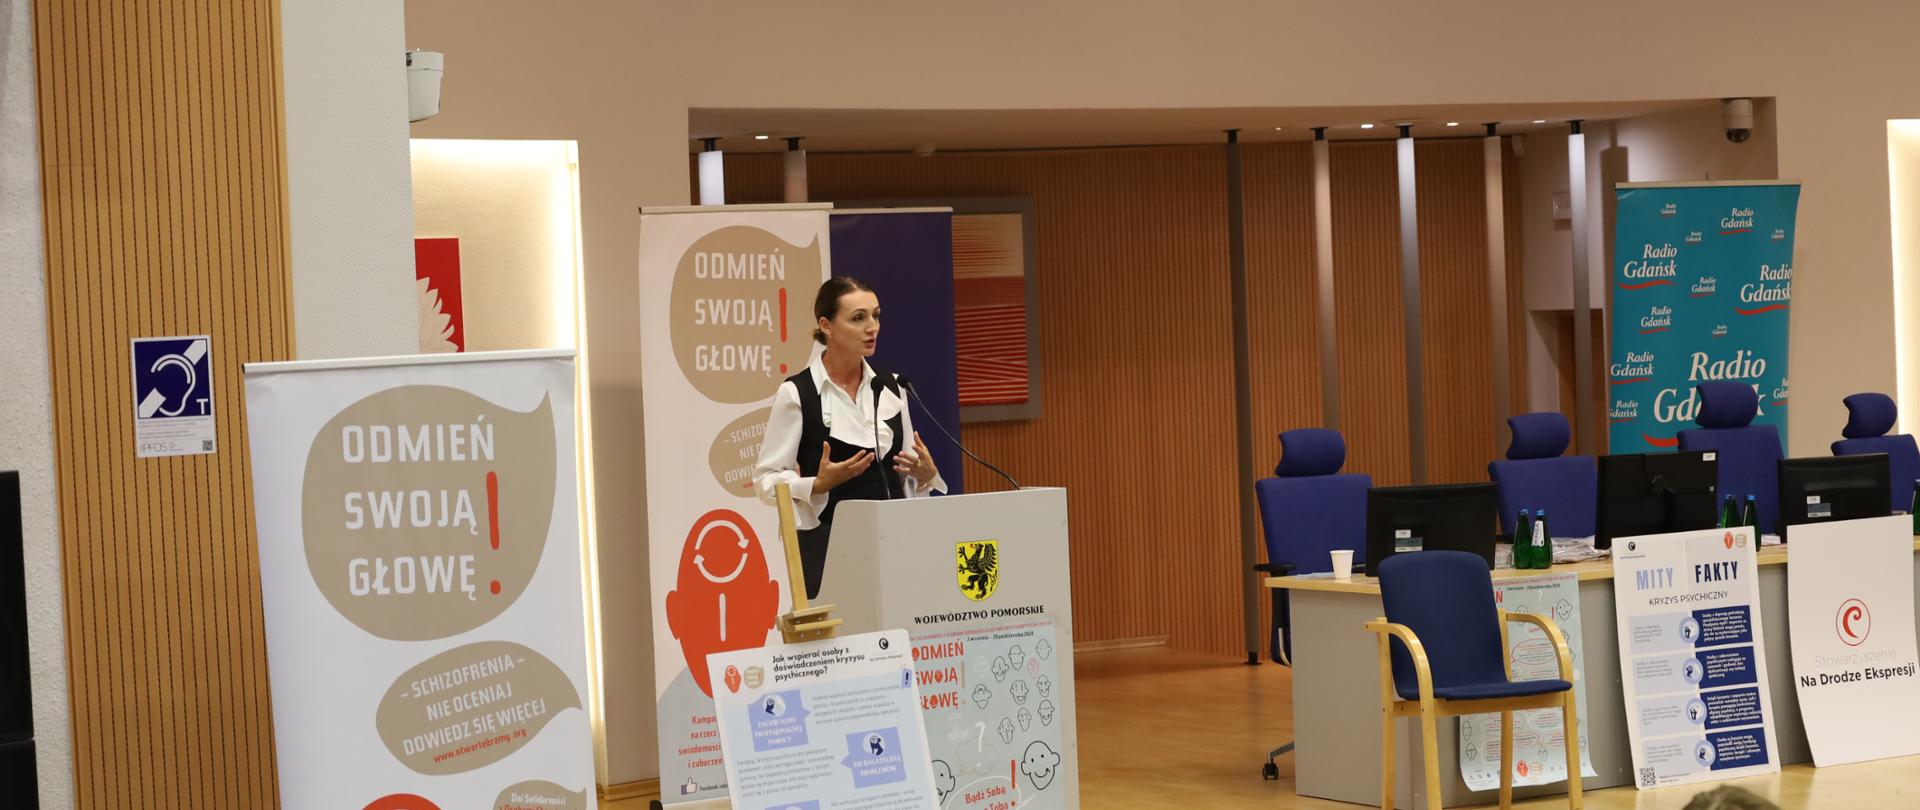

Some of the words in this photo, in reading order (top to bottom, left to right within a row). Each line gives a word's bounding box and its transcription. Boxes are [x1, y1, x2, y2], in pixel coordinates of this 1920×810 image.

[1731, 207, 1754, 217] Radio
[1721, 217, 1754, 229] Gdańsk
[1643, 243, 1678, 259] Radio
[695, 248, 785, 280] ODMIEŃ
[1623, 260, 1677, 278] Gdańsk
[1760, 264, 1792, 281] Radio
[1691, 284, 1716, 293] Gdańsk
[1740, 282, 1792, 302] Gdańsk
[694, 298, 773, 332] SWOJĄ
[1651, 306, 1672, 316] Radio
[1641, 316, 1672, 327] Gdańsk
[695, 344, 772, 378] GŁOWĘ
[1626, 351, 1654, 363] Radio
[1688, 350, 1766, 381] Radio
[1610, 363, 1654, 377] Gdańsk
[196, 398, 208, 415] T
[1616, 400, 1638, 408] Radio
[342, 414, 494, 463] ODMIEŃ
[739, 444, 755, 460] NIE
[344, 489, 478, 535] SWOJĄ
[349, 555, 476, 601] GŁOWĘ
[1636, 568, 1673, 590] MITY
[1695, 561, 1738, 583] FAKTY
[1649, 596, 1679, 606] KRYZYS
[1680, 591, 1729, 603] PSYCHICZNY
[914, 610, 988, 624] WOJEWÓDZTWO
[991, 605, 1045, 618] POMORSKIE
[772, 654, 785, 663] Jak
[786, 649, 821, 661] wspierać
[822, 647, 844, 657] osoby
[773, 657, 836, 672] doświadczeniem
[836, 654, 865, 665] kryzysu
[1815, 649, 1897, 668] Stowarzyszenie
[411, 653, 515, 698] SCHIZOFRENIA
[775, 666, 828, 682] psychicznego?
[1800, 675, 1817, 687] Na
[1820, 670, 1861, 685] Drodze
[1865, 662, 1915, 680] Ekspresji
[426, 702, 451, 721] NIE
[453, 681, 513, 713] OCENIAJ
[403, 723, 471, 756] DOWIEDZ
[474, 714, 496, 734] SIĘ
[496, 698, 546, 728] WIĘCEJ
[691, 731, 699, 740] na
[699, 730, 717, 739] rzecz
[512, 792, 523, 802] Dni
